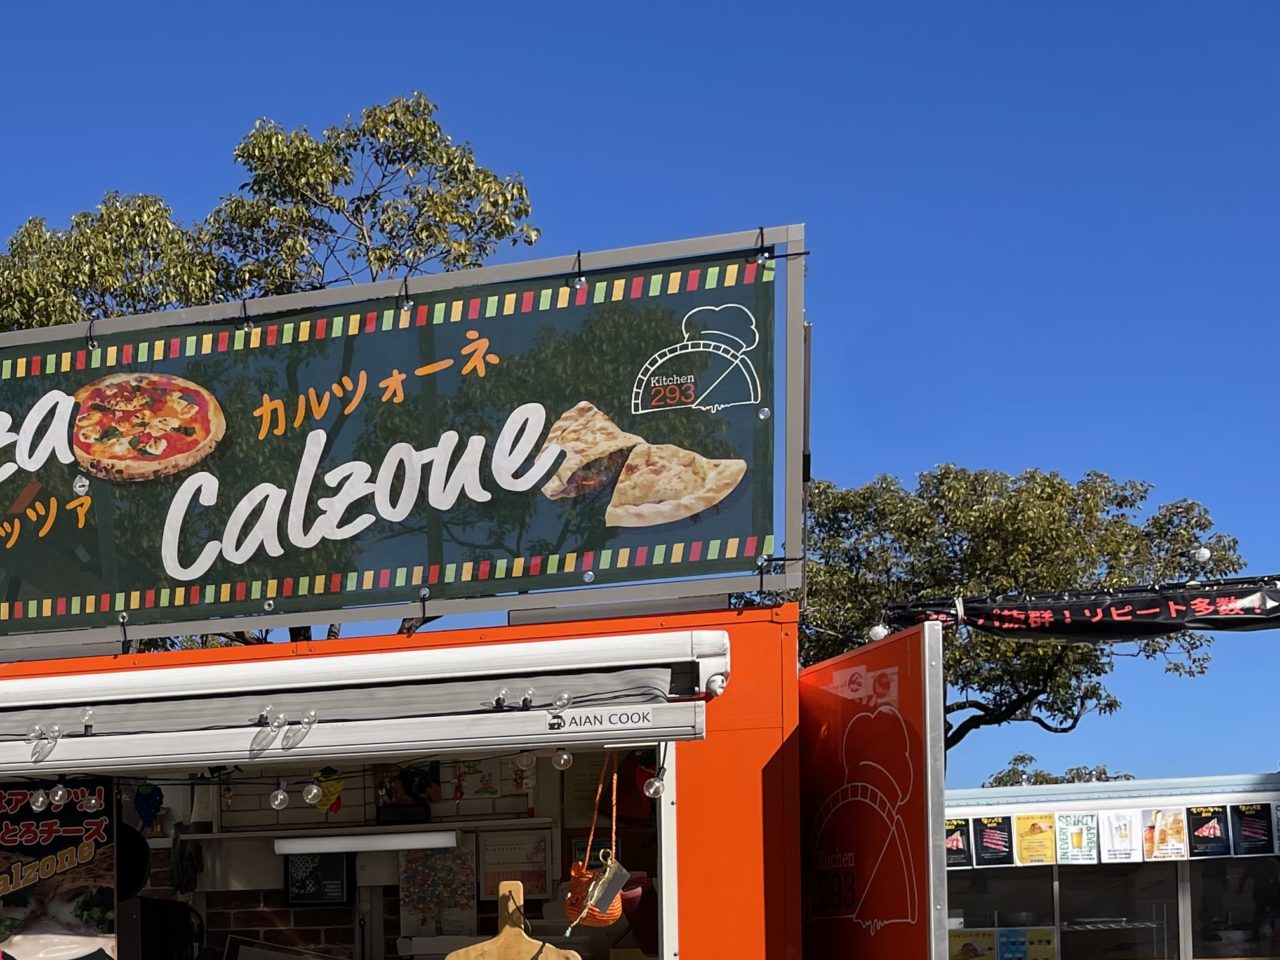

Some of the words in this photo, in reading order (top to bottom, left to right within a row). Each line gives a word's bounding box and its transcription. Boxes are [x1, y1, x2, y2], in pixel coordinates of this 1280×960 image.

[253, 329, 501, 440] カルツォーネ
[650, 374, 695, 387] Kitchen
[650, 383, 696, 406] 293
[160, 401, 568, 581] Calzone
[569, 714, 603, 727] AIAN
[608, 711, 651, 725] COOK
